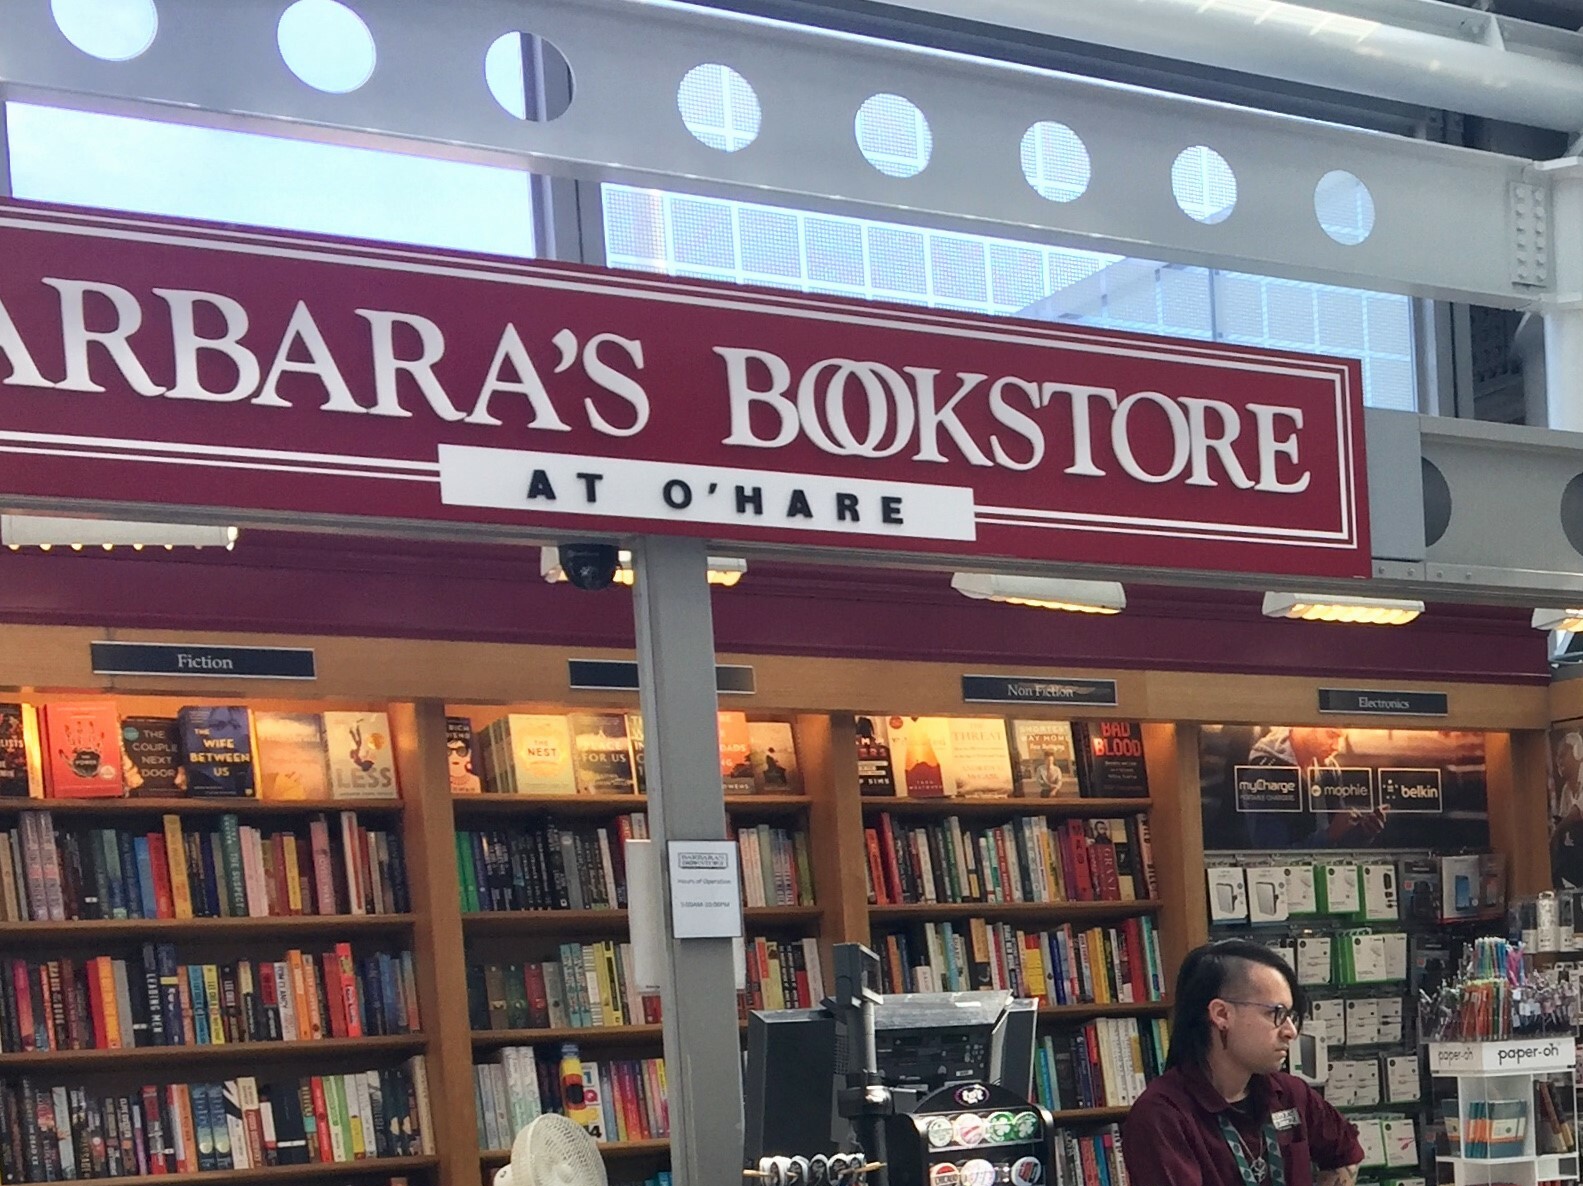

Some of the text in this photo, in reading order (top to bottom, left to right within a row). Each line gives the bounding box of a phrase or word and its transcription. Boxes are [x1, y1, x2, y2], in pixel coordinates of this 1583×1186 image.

[713, 345, 1310, 494] BOOKSTORE
[527, 469, 904, 525] AT O'HARE
[178, 654, 233, 669] Fiction
[1008, 684, 1074, 698] Non Fiction
[1358, 697, 1410, 709] Electronics
[143, 730, 165, 739] THE
[1101, 721, 1130, 737] BAD
[132, 743, 178, 752] COUPLE
[203, 739, 234, 749] WIFE
[1093, 738, 1141, 756] BLOOD
[189, 752, 249, 763] BETWEEN
[527, 748, 557, 757] NEST
[583, 753, 627, 763] FOR US
[141, 756, 172, 765] NEXT
[140, 768, 176, 777] DOOR
[213, 767, 230, 777] US
[336, 767, 393, 788] LESS
[1239, 778, 1296, 794] myCharge
[1324, 783, 1368, 798] mophie
[1401, 785, 1438, 798] belkin
[232, 871, 244, 908] SUSPECT
[146, 973, 163, 1033] LEADING MEN
[1438, 1047, 1473, 1066] paper-oh
[1498, 1042, 1559, 1066] paper-oh
